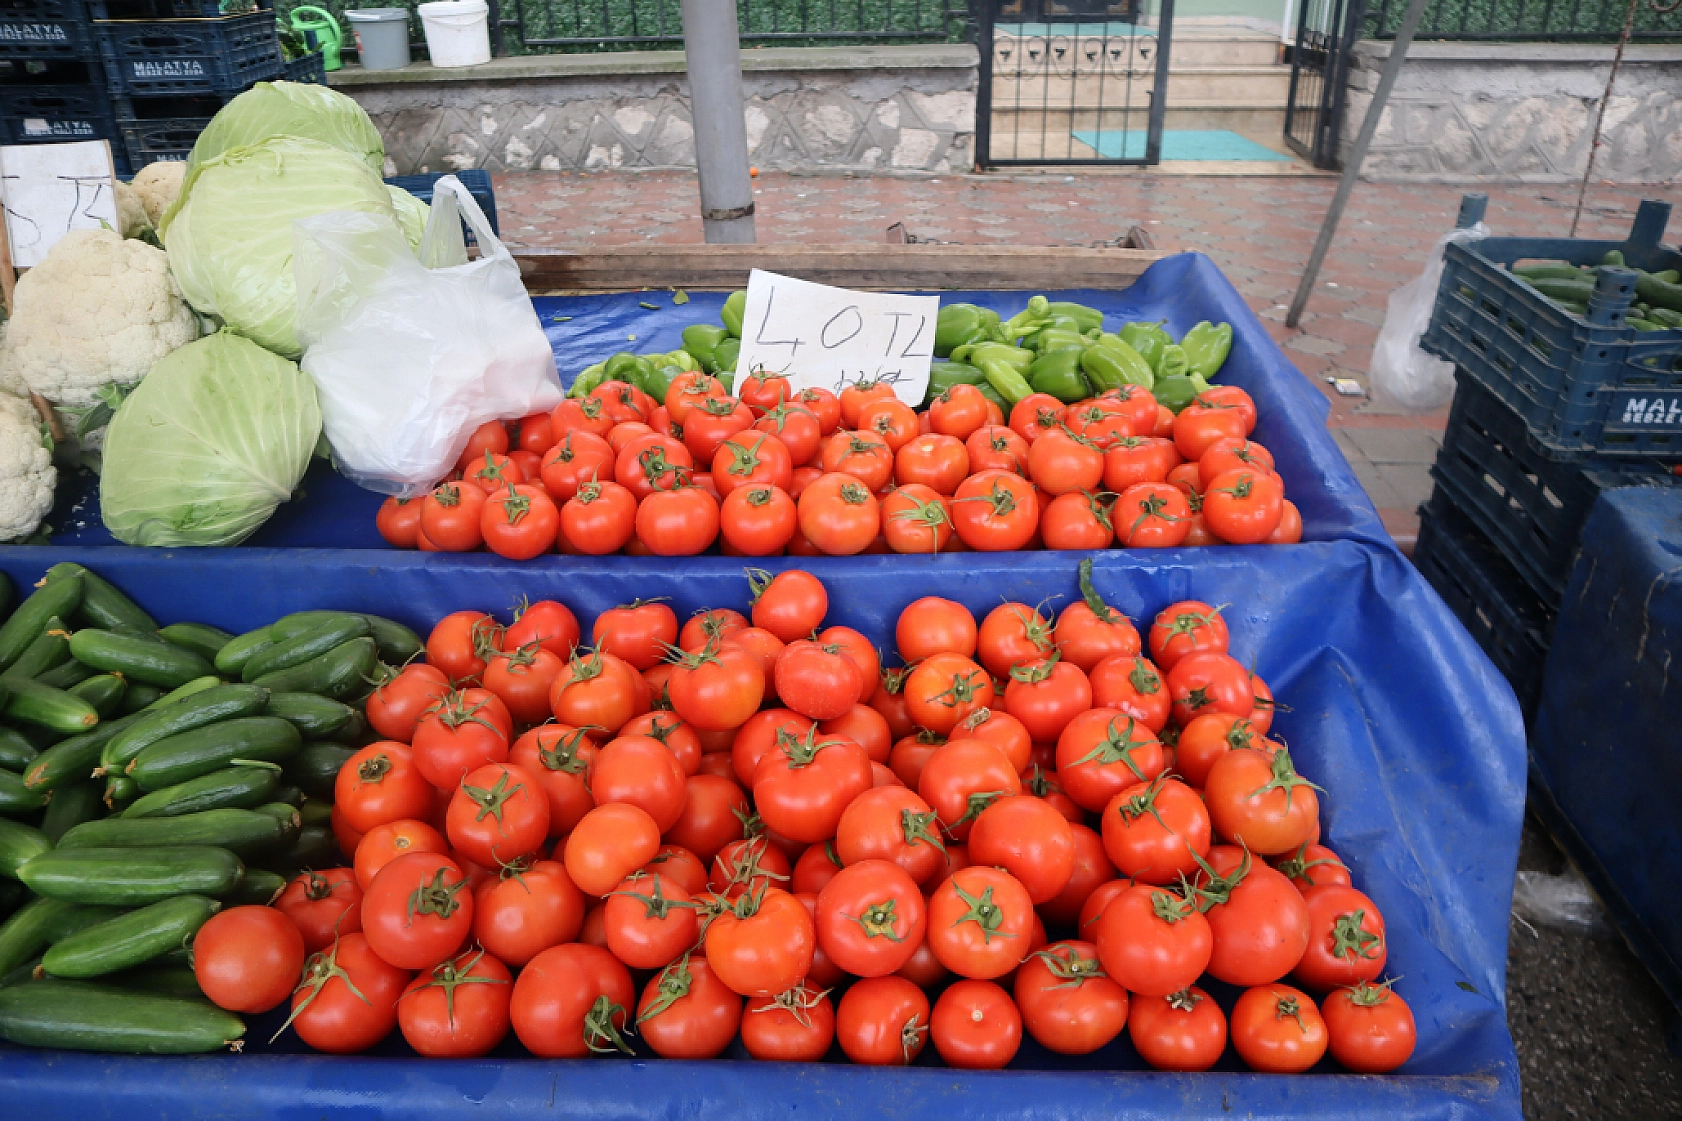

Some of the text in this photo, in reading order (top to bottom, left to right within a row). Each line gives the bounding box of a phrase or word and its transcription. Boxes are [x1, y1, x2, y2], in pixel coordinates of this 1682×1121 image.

[0, 24, 64, 34] ALATYA
[133, 61, 202, 70] MALATYA
[884, 312, 939, 358] TL
